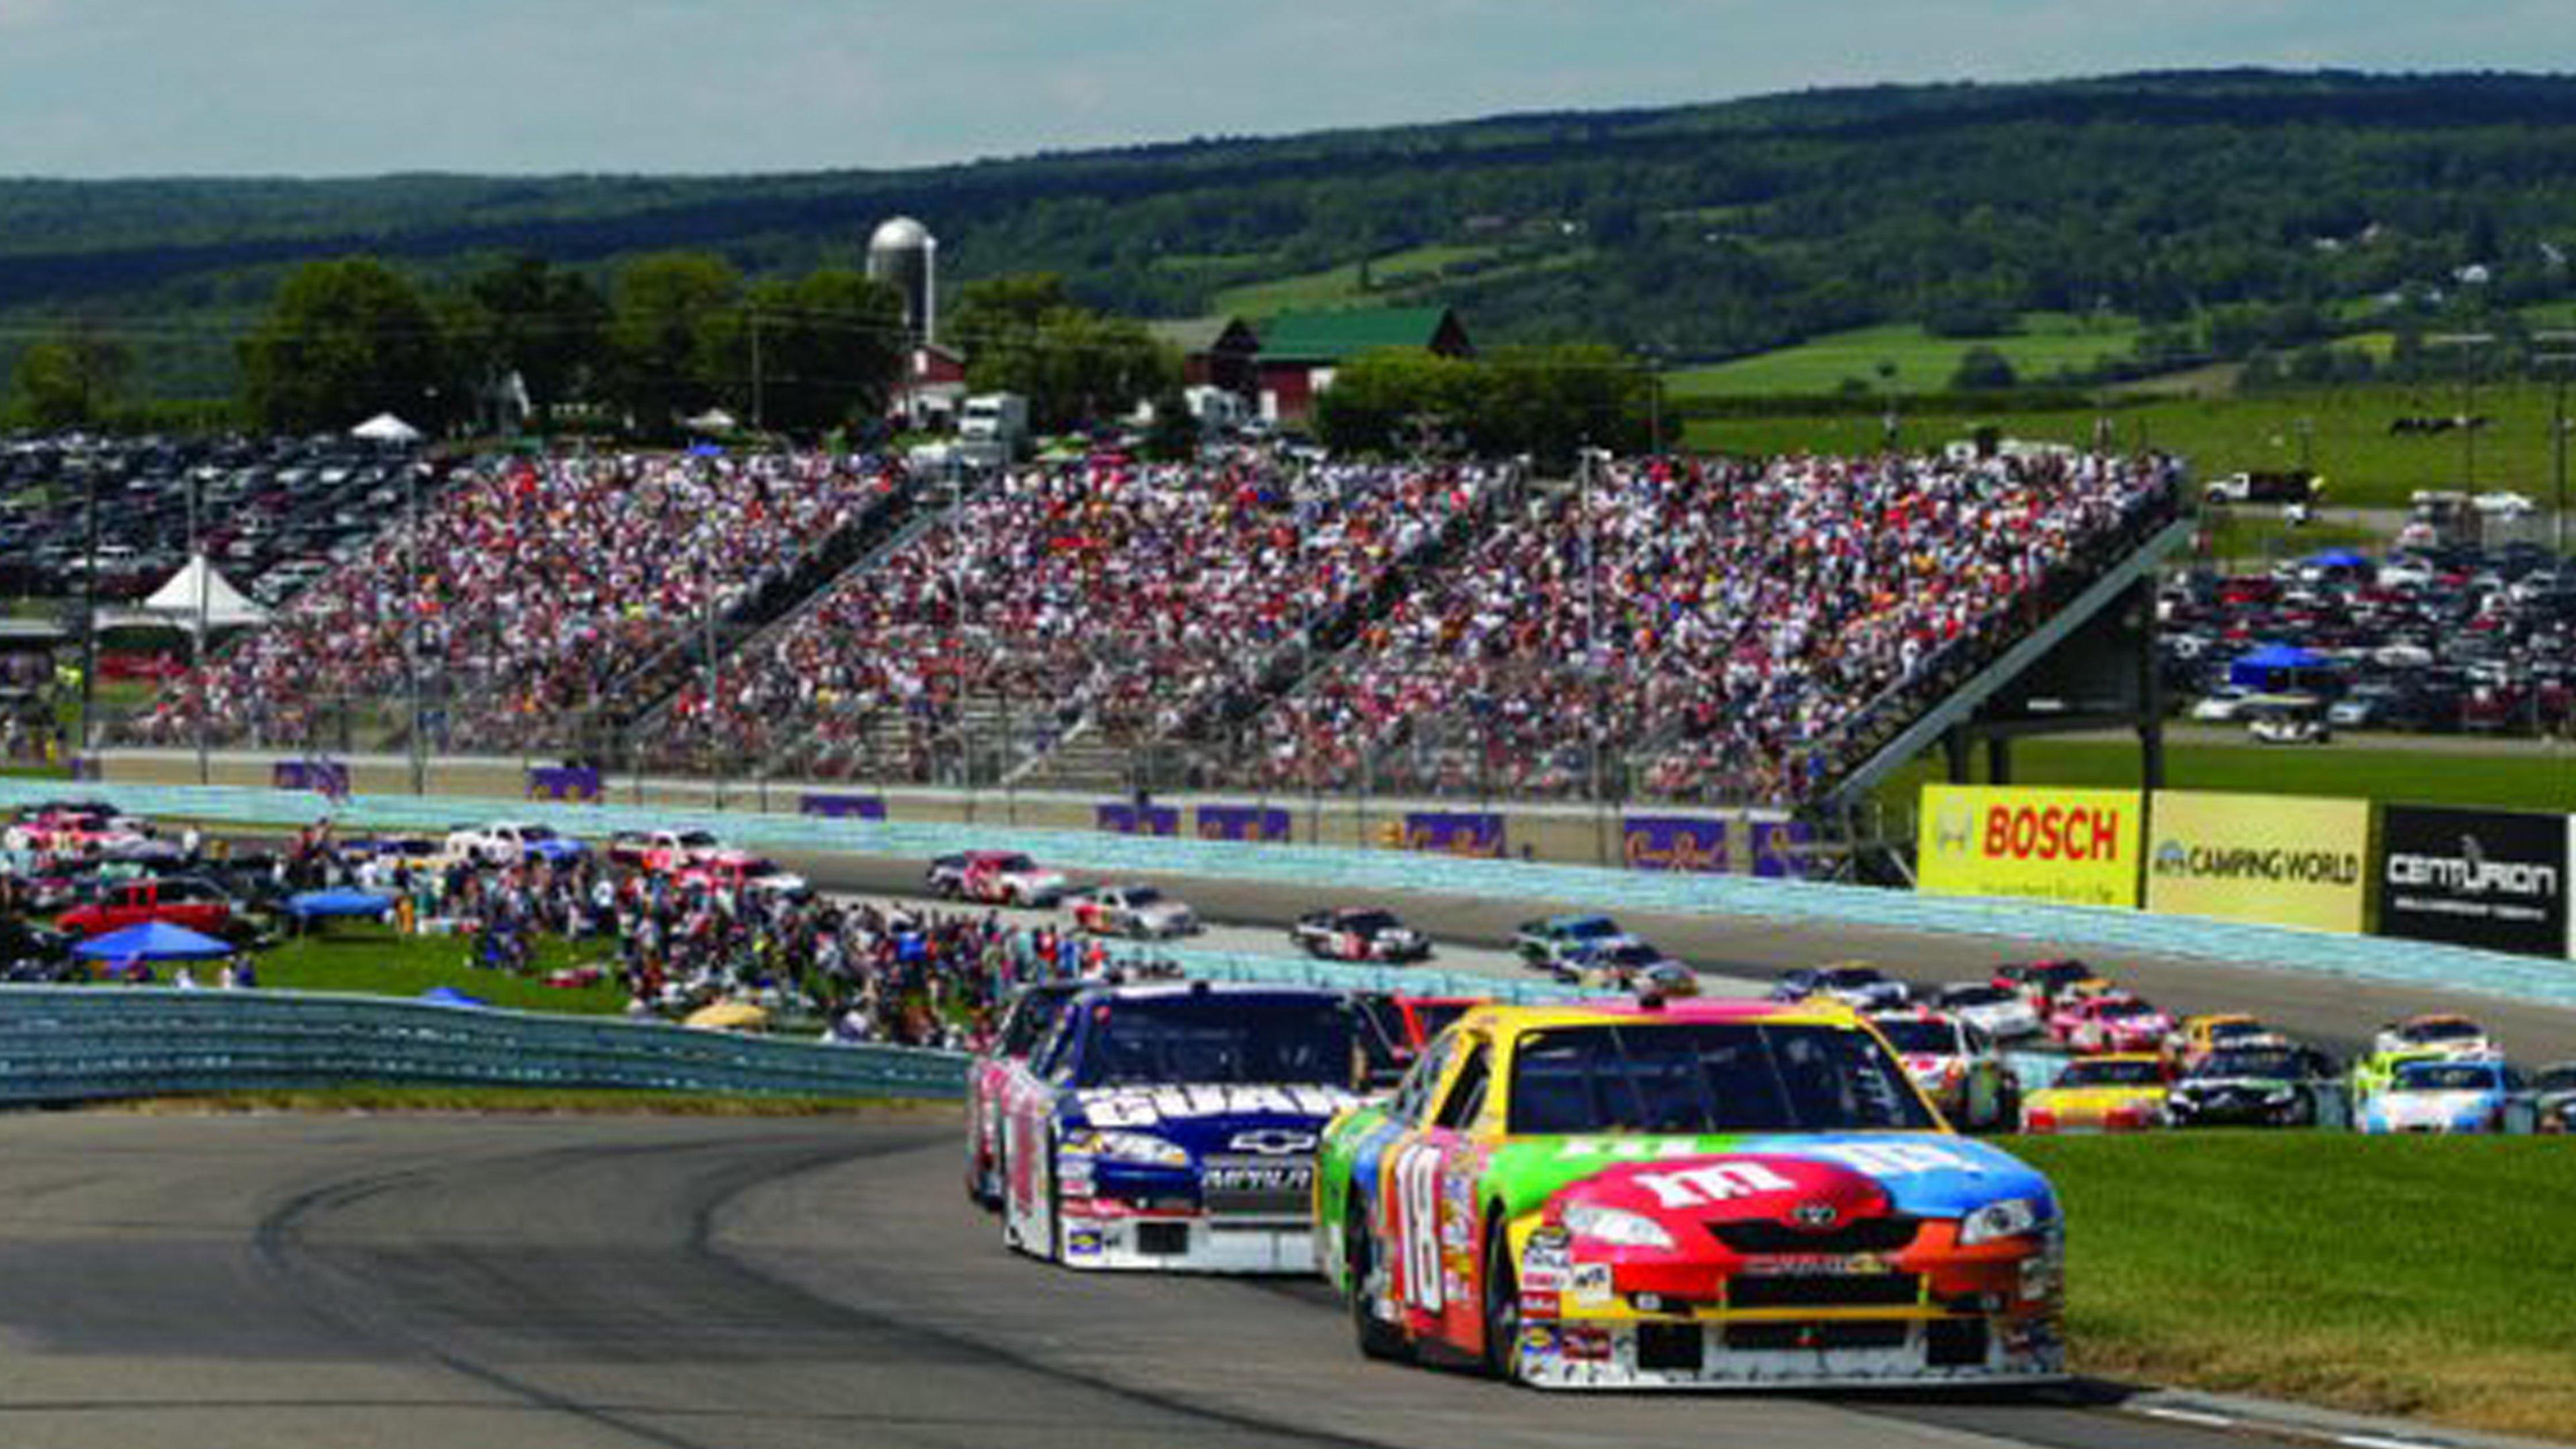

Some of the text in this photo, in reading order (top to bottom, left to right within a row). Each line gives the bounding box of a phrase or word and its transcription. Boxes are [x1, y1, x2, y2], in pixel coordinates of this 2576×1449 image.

[1983, 804, 2118, 861] BOSCH
[2189, 846, 2359, 884] CAMPING WORLD
[1395, 1143, 1442, 1311] 18
